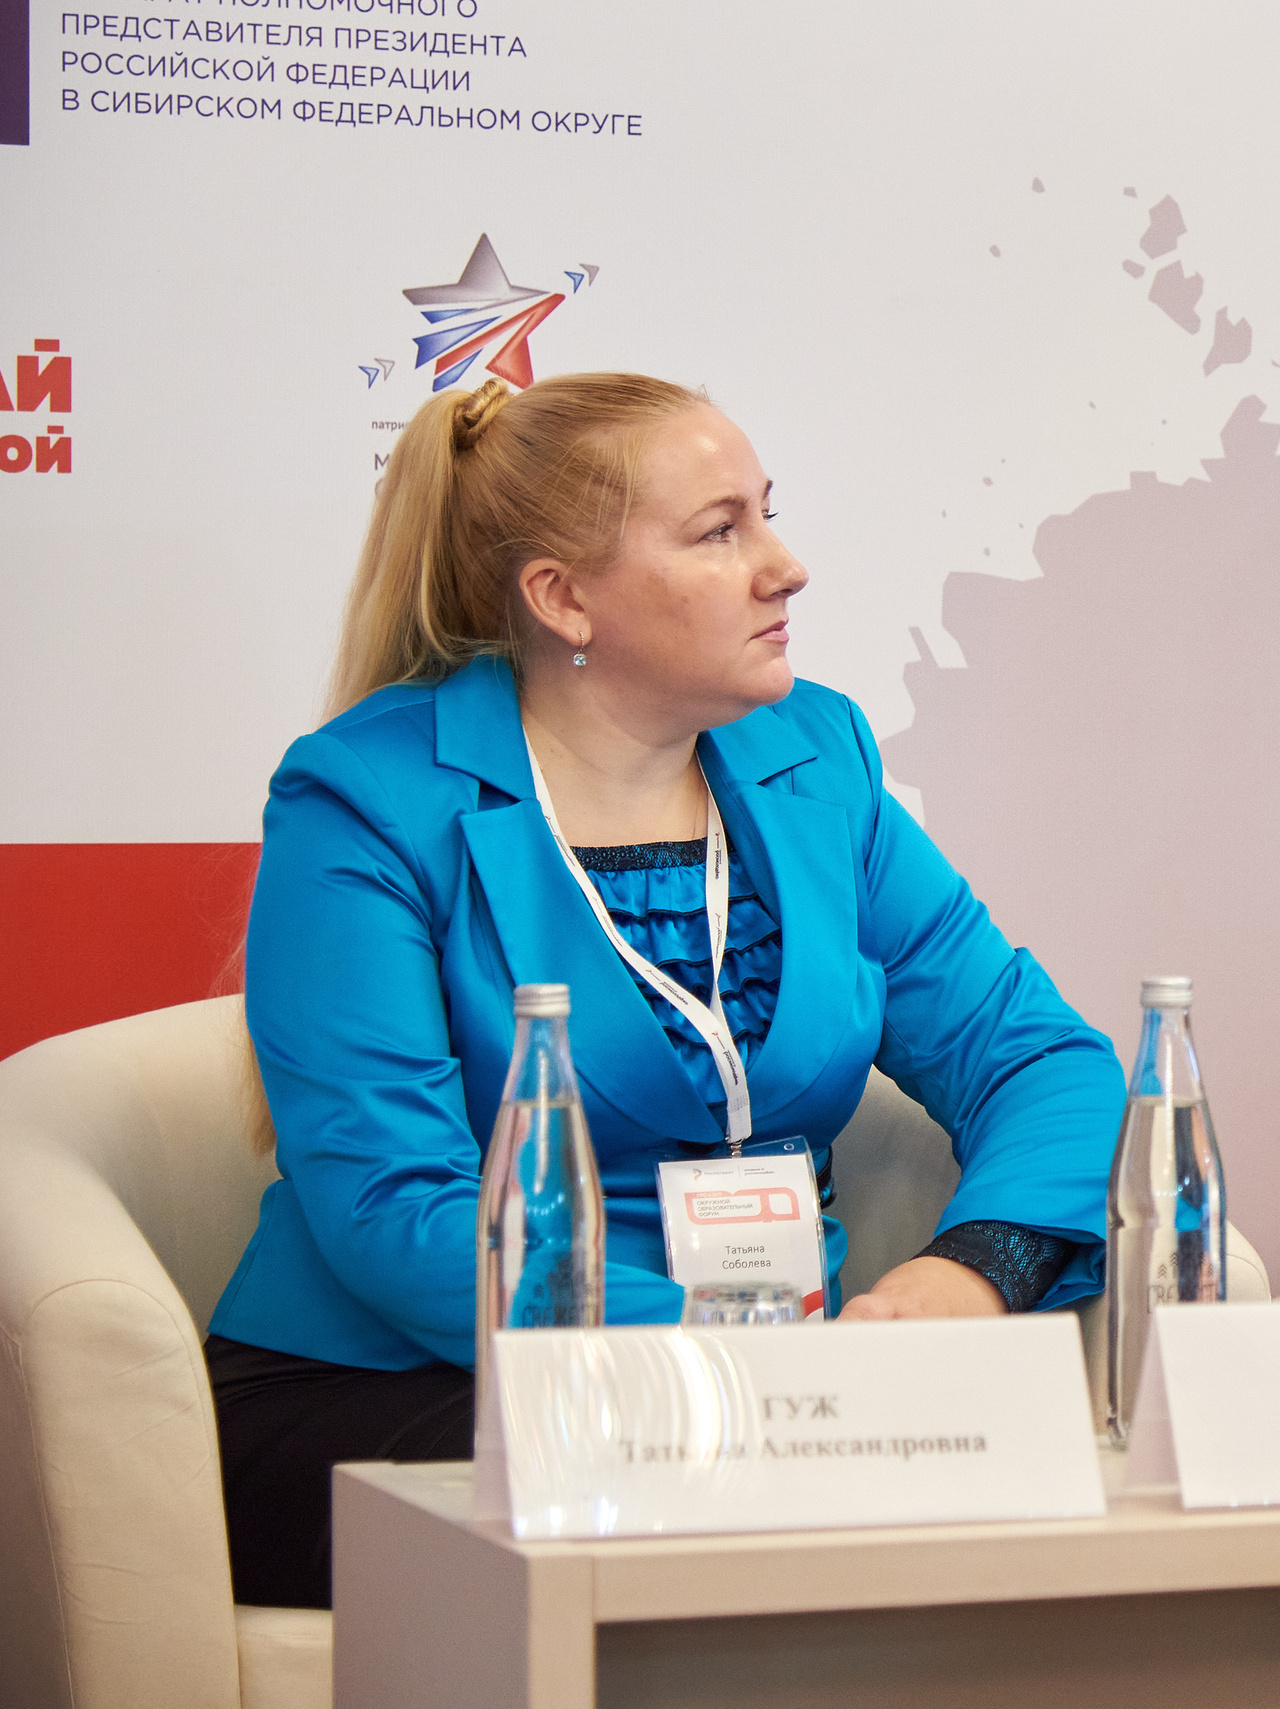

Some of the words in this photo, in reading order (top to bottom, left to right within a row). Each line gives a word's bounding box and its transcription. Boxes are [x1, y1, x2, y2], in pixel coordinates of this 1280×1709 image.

[61, 13, 323, 48] ПРЕДСТАВИТЕЛЯ
[335, 28, 527, 58] ПРЕЗИДЕНТА
[61, 51, 275, 83] РОССИЙСКОЙ
[286, 62, 471, 94] ФЕДЕРАЦИИ
[61, 88, 80, 111] В
[90, 91, 282, 120] СИБИРСКОМ
[292, 100, 521, 131] ФЕДЕРАЛЬНОМ
[531, 111, 643, 136] ОКРУГЕ
[722, 1258, 771, 1270] Соболева
[725, 1245, 765, 1255] Татьяна
[762, 1395, 840, 1420] ГУЖ
[760, 1433, 989, 1461] Александровна
